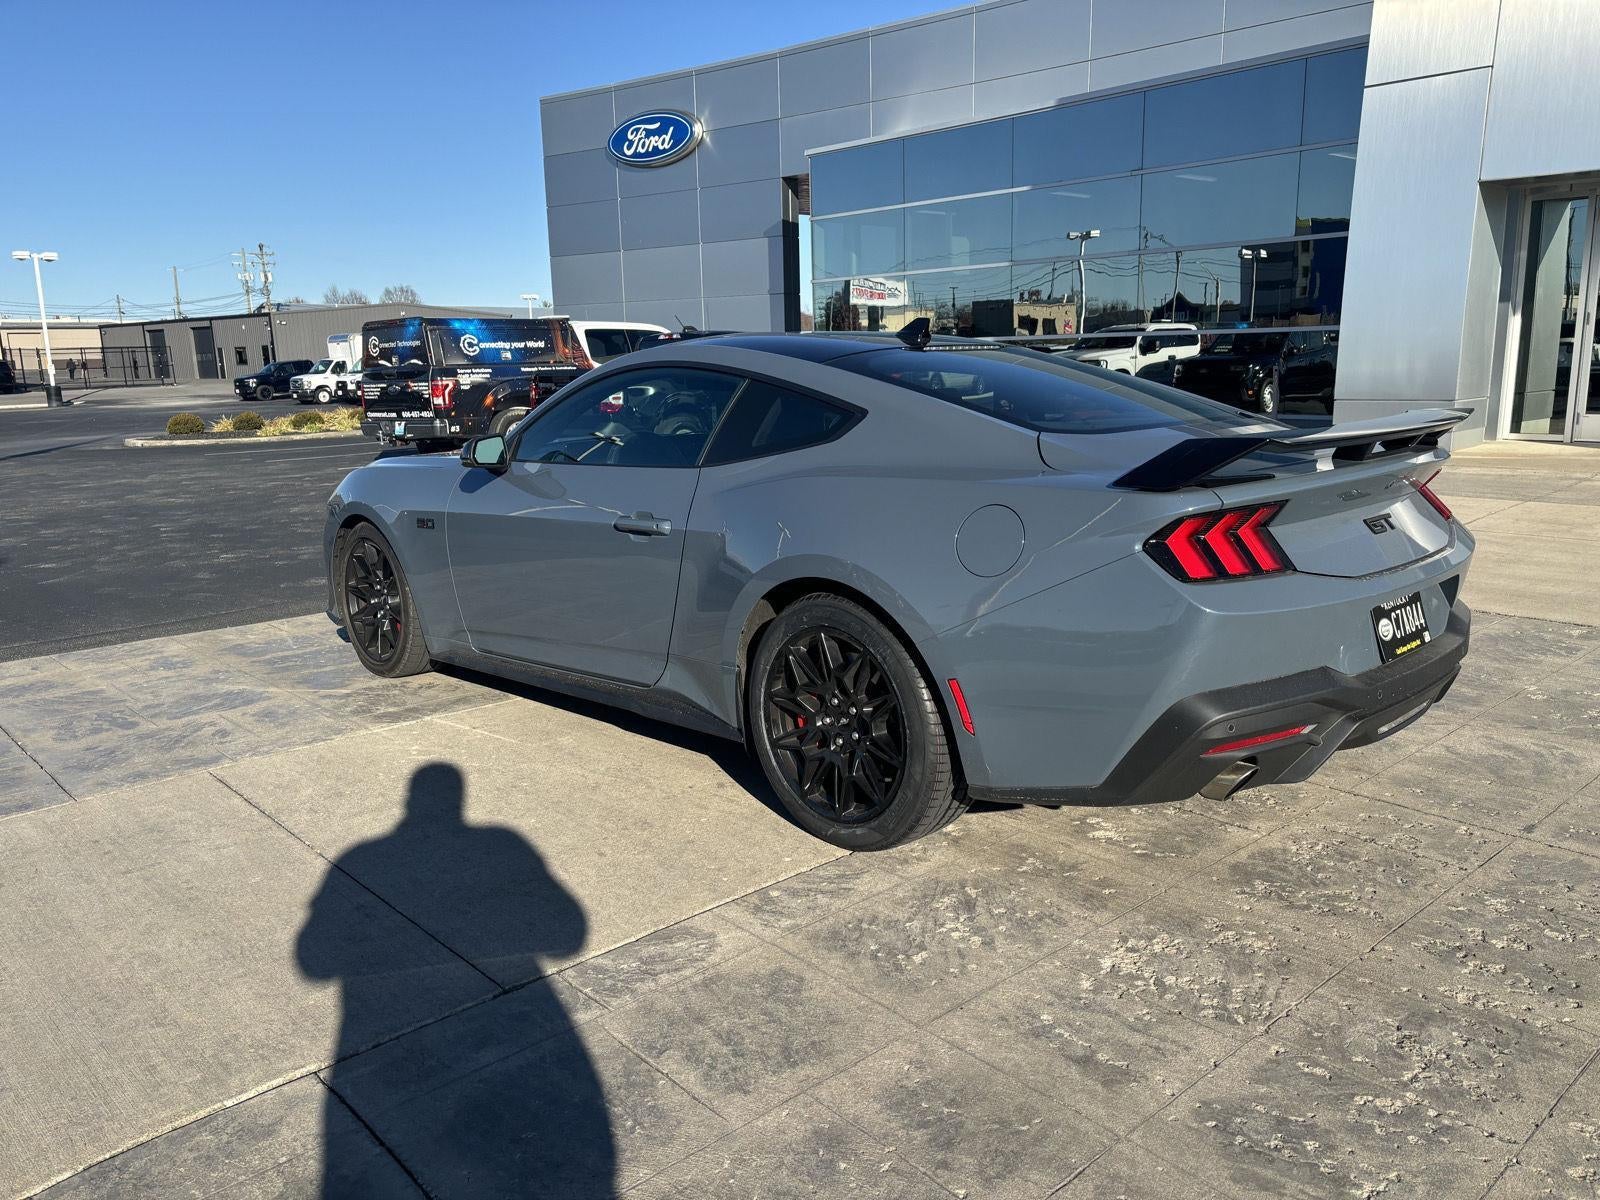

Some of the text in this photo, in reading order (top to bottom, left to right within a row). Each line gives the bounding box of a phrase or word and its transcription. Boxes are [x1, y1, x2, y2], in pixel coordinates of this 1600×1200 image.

[624, 122, 674, 155] Ford
[460, 334, 511, 356] Connecting
[1363, 512, 1396, 535] GT
[1391, 602, 1426, 639] C7A844
